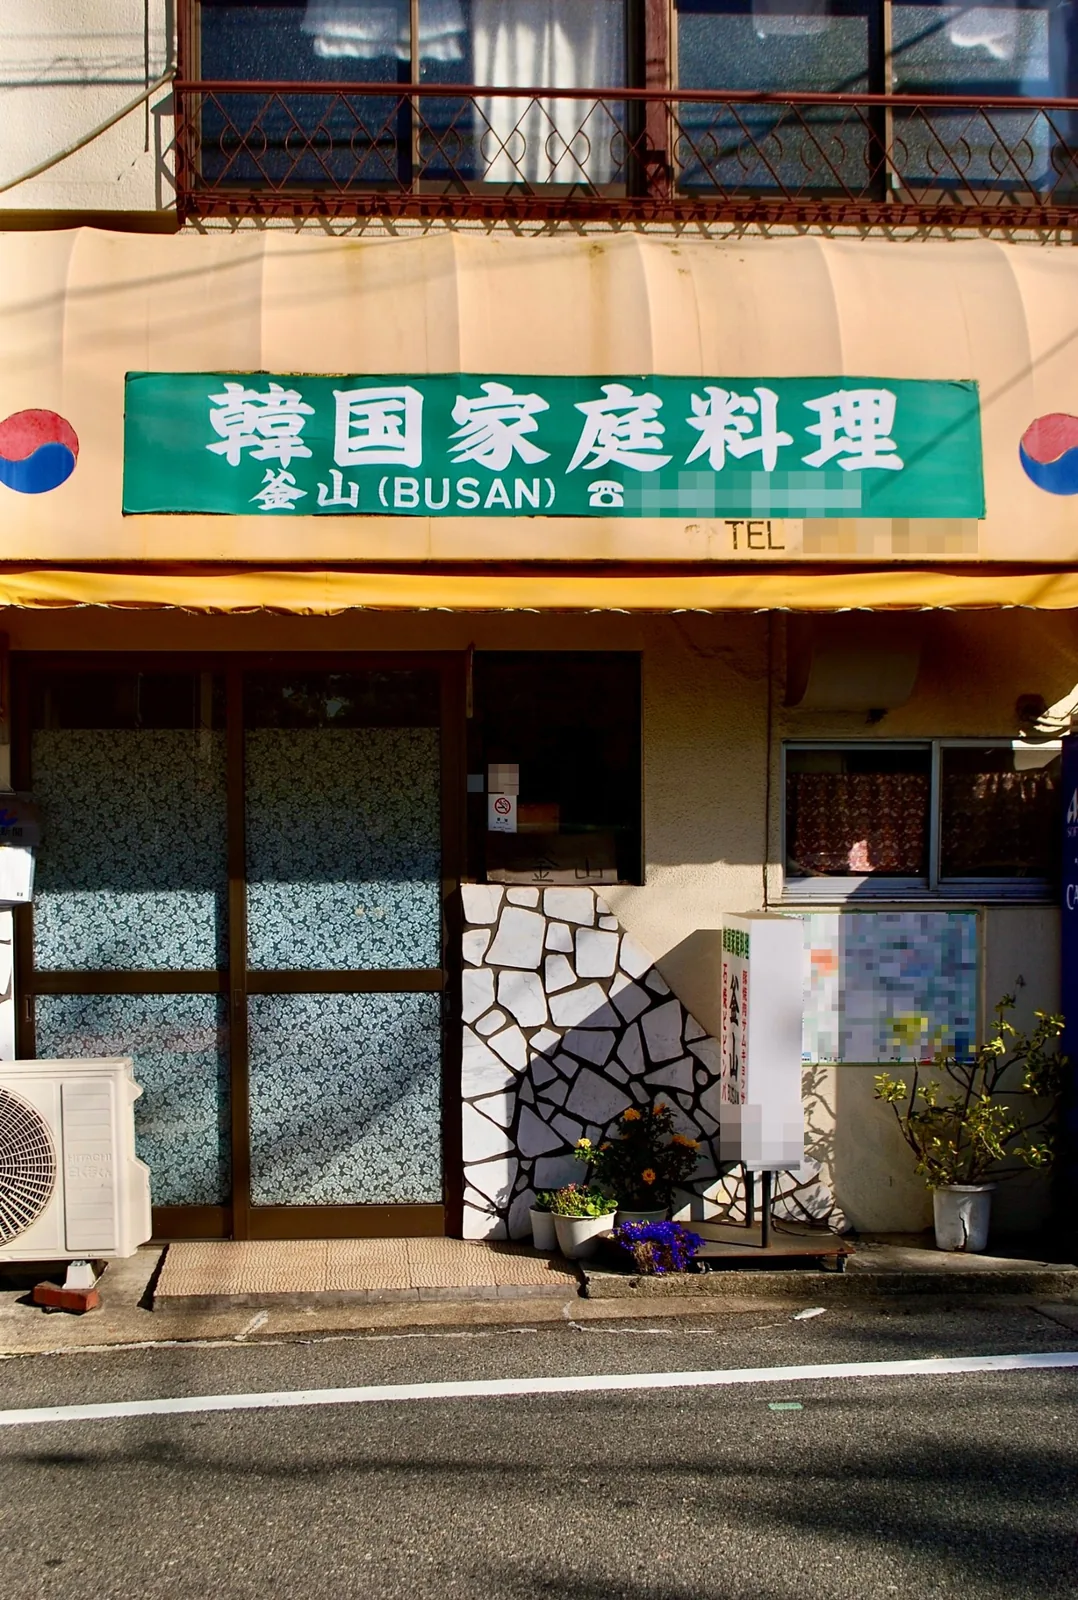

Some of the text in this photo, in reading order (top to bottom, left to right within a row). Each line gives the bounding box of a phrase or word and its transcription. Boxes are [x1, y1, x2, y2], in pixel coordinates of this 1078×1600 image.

[205, 382, 905, 474] 韓国家庭料理
[248, 468, 556, 510] 釜山 (BUSAN)
[724, 520, 785, 550] TEL
[729, 974, 740, 1082] 釜山
